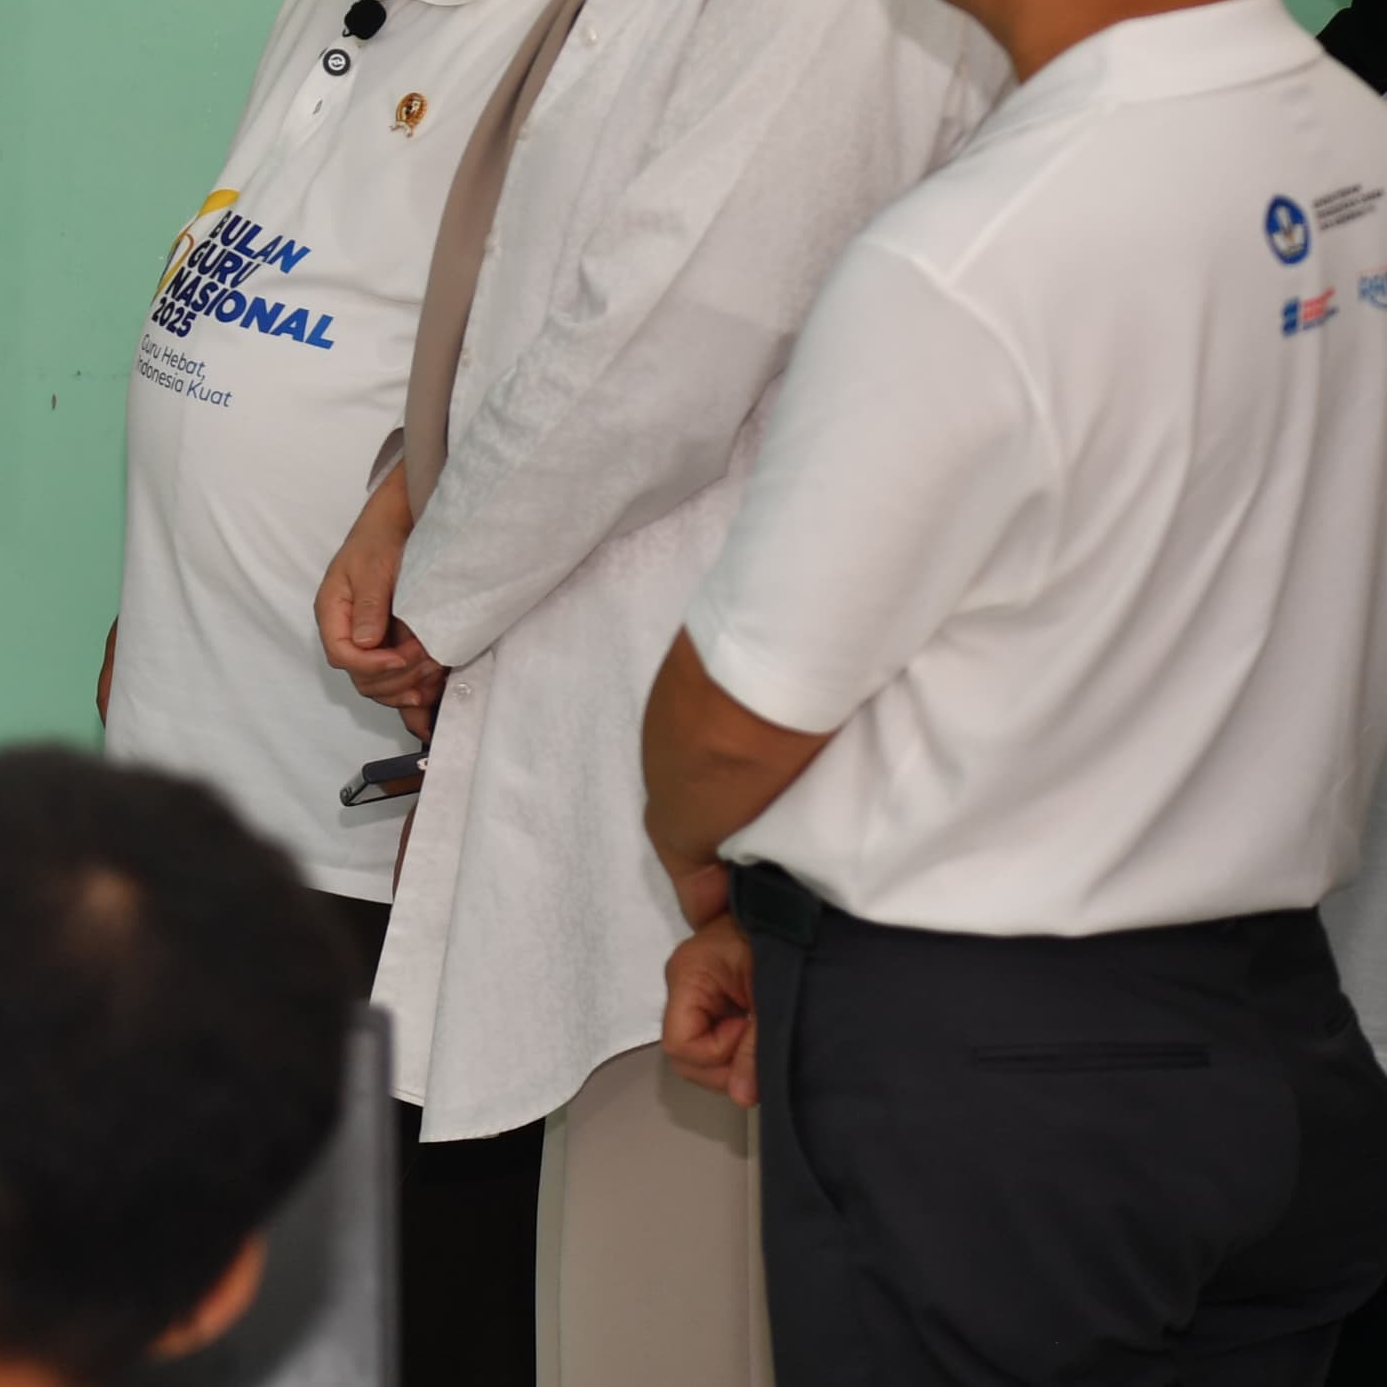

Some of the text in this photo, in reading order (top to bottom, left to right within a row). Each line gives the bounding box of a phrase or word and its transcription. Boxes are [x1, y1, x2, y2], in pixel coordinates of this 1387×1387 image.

[187, 239, 262, 289] GURU
[150, 296, 197, 338] 2025
[164, 266, 334, 350] NASIONAL
[161, 345, 206, 383] Hebat,
[186, 379, 233, 407] Kuat
